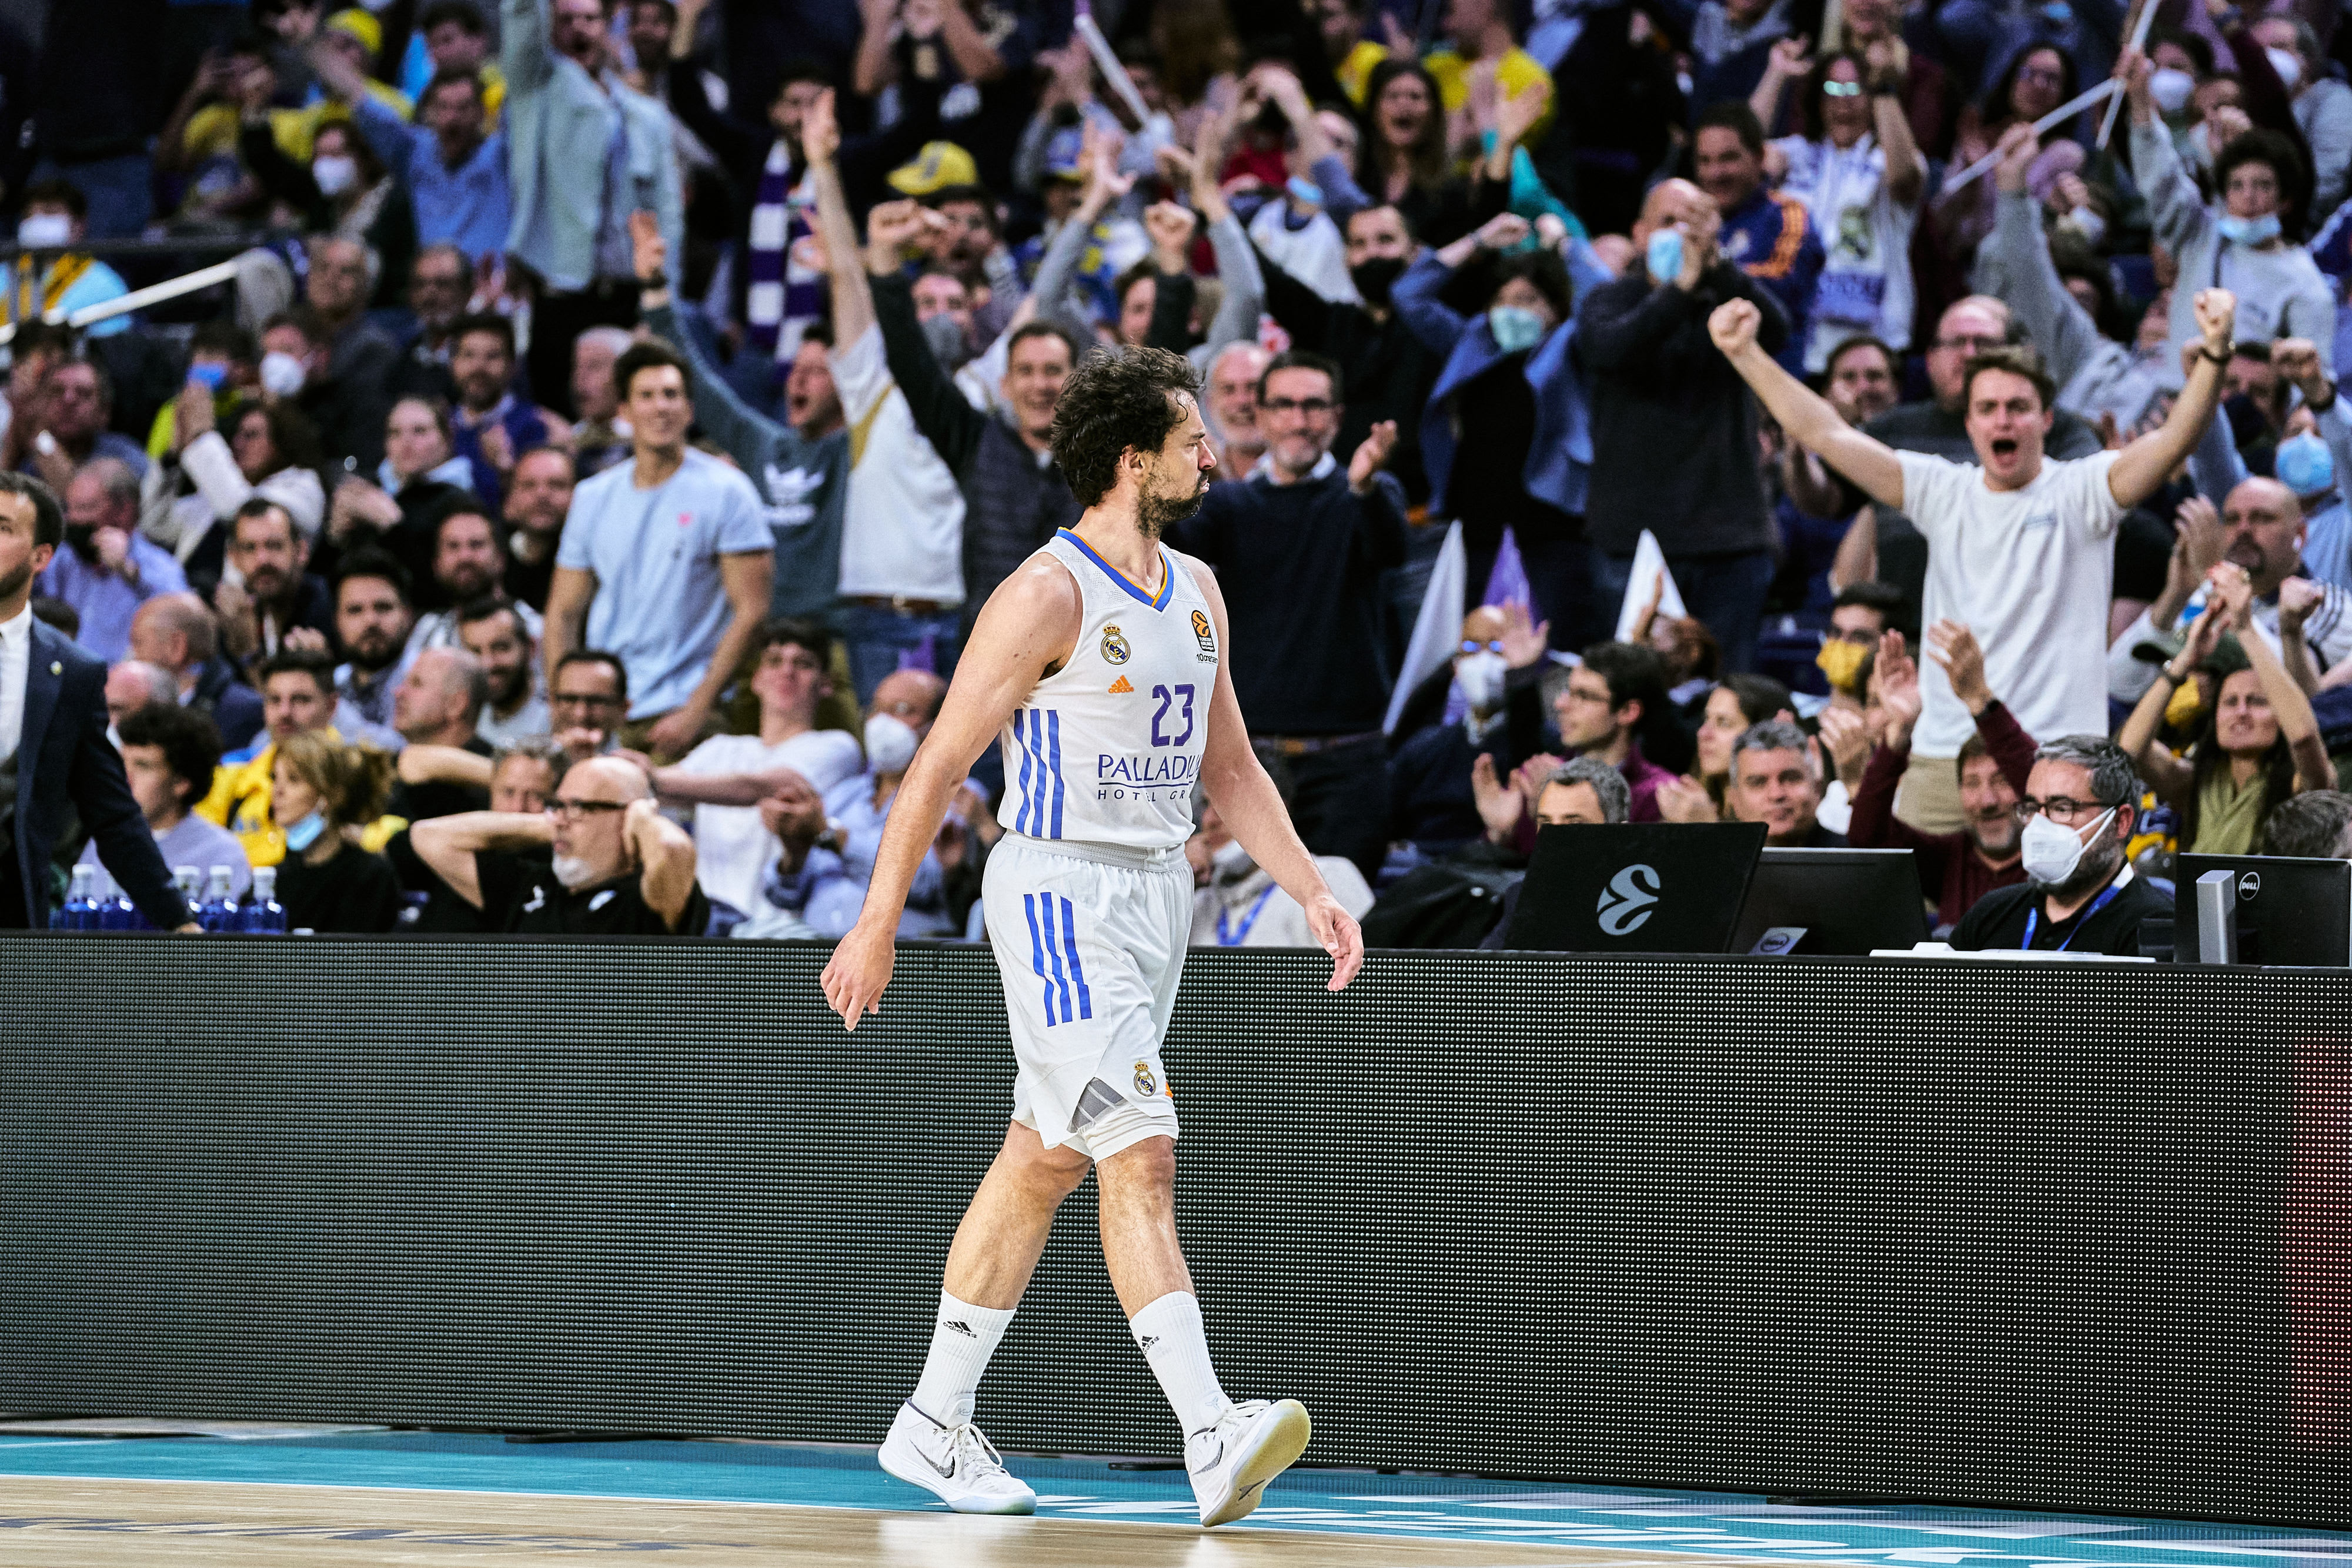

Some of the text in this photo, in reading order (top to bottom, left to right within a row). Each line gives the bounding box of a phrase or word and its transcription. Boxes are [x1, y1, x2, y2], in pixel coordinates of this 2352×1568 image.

[1151, 684, 1195, 747] 23
[2241, 882, 2257, 890] DELL
[943, 1322, 977, 1338] adidas
[0, 1515, 761, 1551] RLINES
